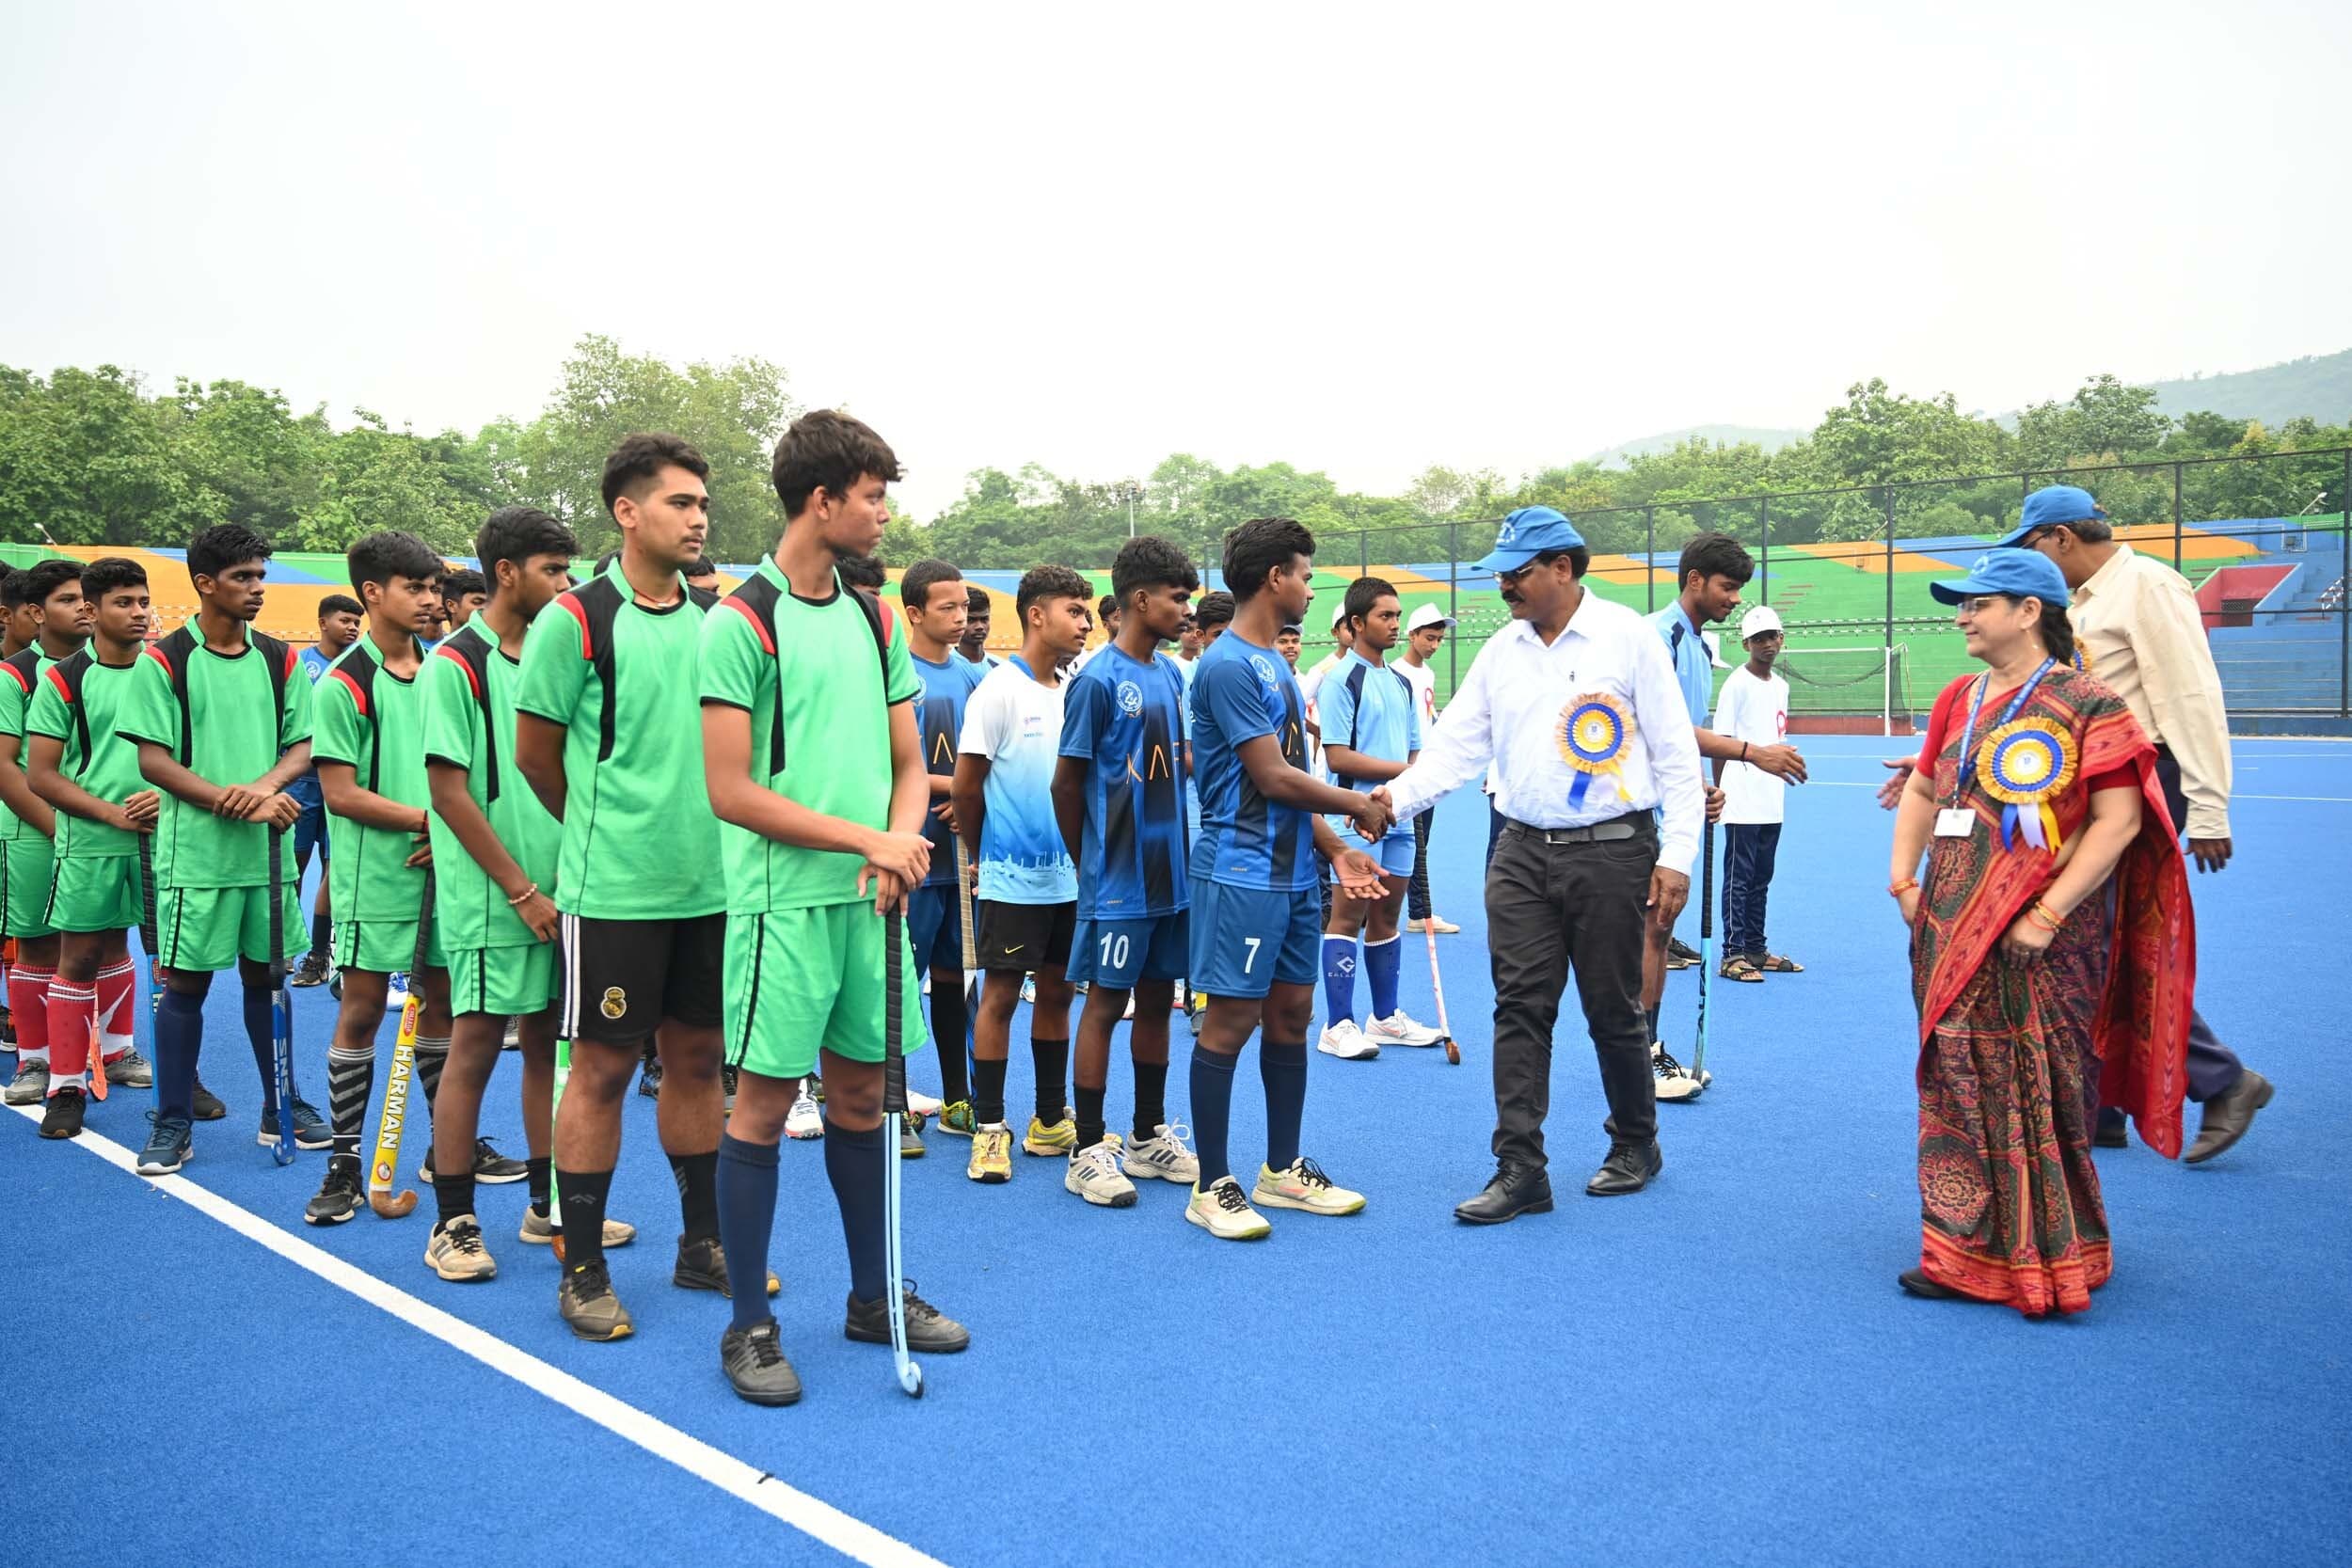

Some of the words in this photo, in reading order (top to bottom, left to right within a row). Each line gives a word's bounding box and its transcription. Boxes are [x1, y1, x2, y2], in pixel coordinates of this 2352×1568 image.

[1100, 931, 1129, 970] 10
[1244, 937, 1262, 974] 7
[380, 1045, 414, 1149] HARMAN
